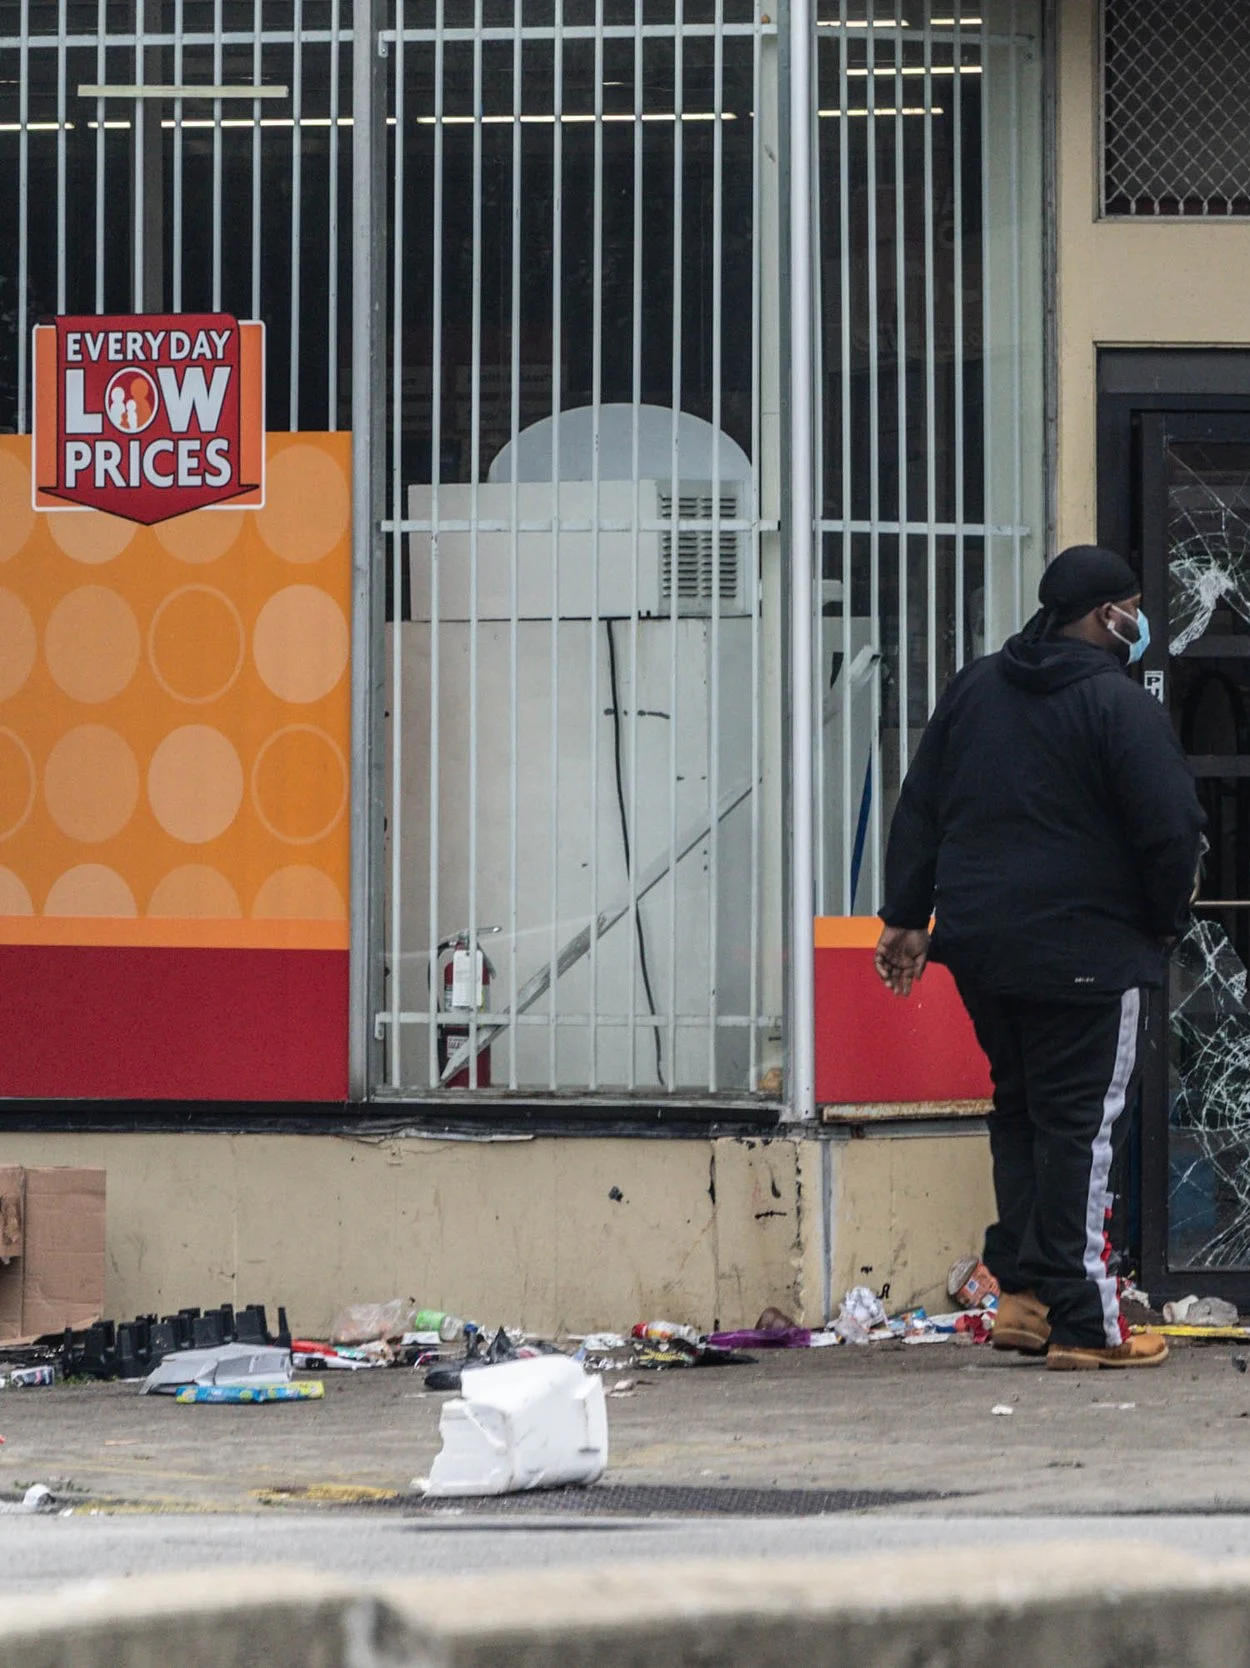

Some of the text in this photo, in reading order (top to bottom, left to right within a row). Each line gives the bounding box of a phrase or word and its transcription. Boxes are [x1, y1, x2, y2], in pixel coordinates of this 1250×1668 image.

[66, 329, 232, 362] EVERYDAY
[64, 366, 232, 434] LOW
[64, 439, 233, 489] PRICES
